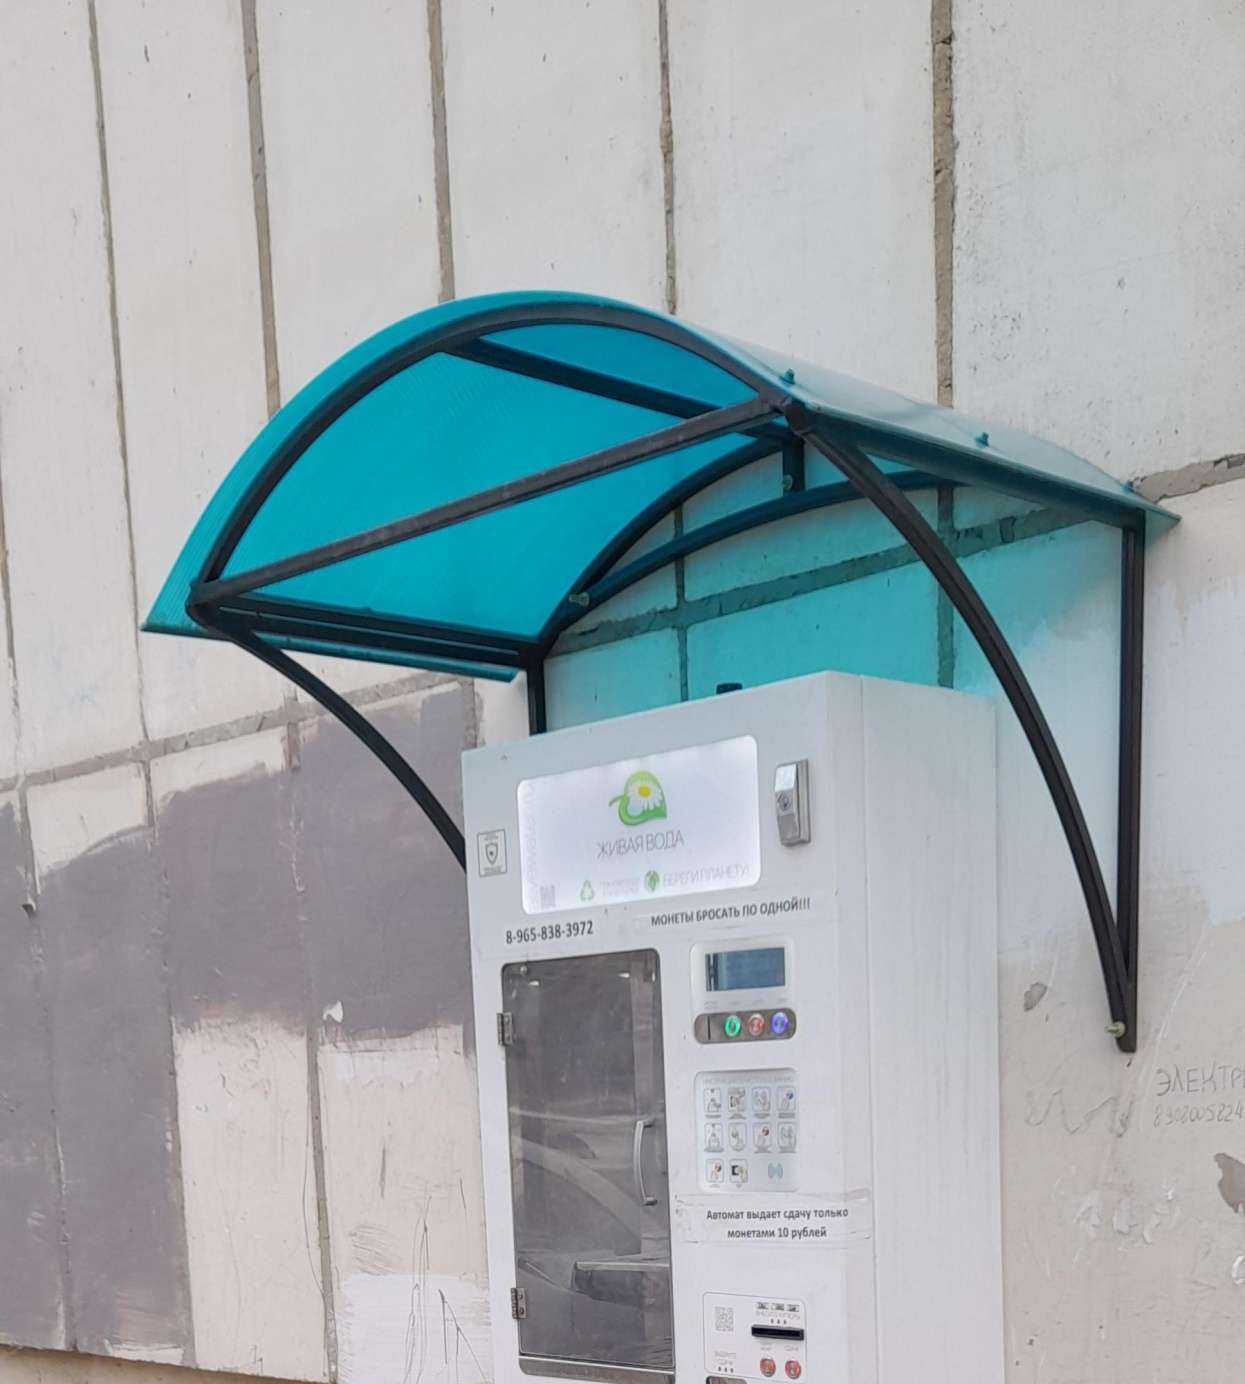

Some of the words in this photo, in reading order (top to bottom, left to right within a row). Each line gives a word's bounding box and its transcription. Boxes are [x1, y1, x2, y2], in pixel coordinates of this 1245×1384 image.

[597, 834, 644, 858] ЖИВАЯ
[646, 830, 685, 852] ВОДА
[651, 911, 694, 927] МОНЕТЫ
[696, 907, 740, 922] БРОСАТЬ
[742, 904, 757, 917] ПО
[760, 896, 811, 916] ОДНОЙ!!!
[506, 920, 594, 944] 8-965-838-3972
[1156, 1062, 1245, 1096] ЭЛЕКТР
[706, 1209, 744, 1220] Автомат
[746, 1209, 781, 1221] выдает
[783, 1209, 811, 1220] сдачу
[813, 1208, 849, 1218] только
[727, 1229, 775, 1239] монетами
[777, 1227, 789, 1238] 10
[791, 1226, 827, 1240] рублей
